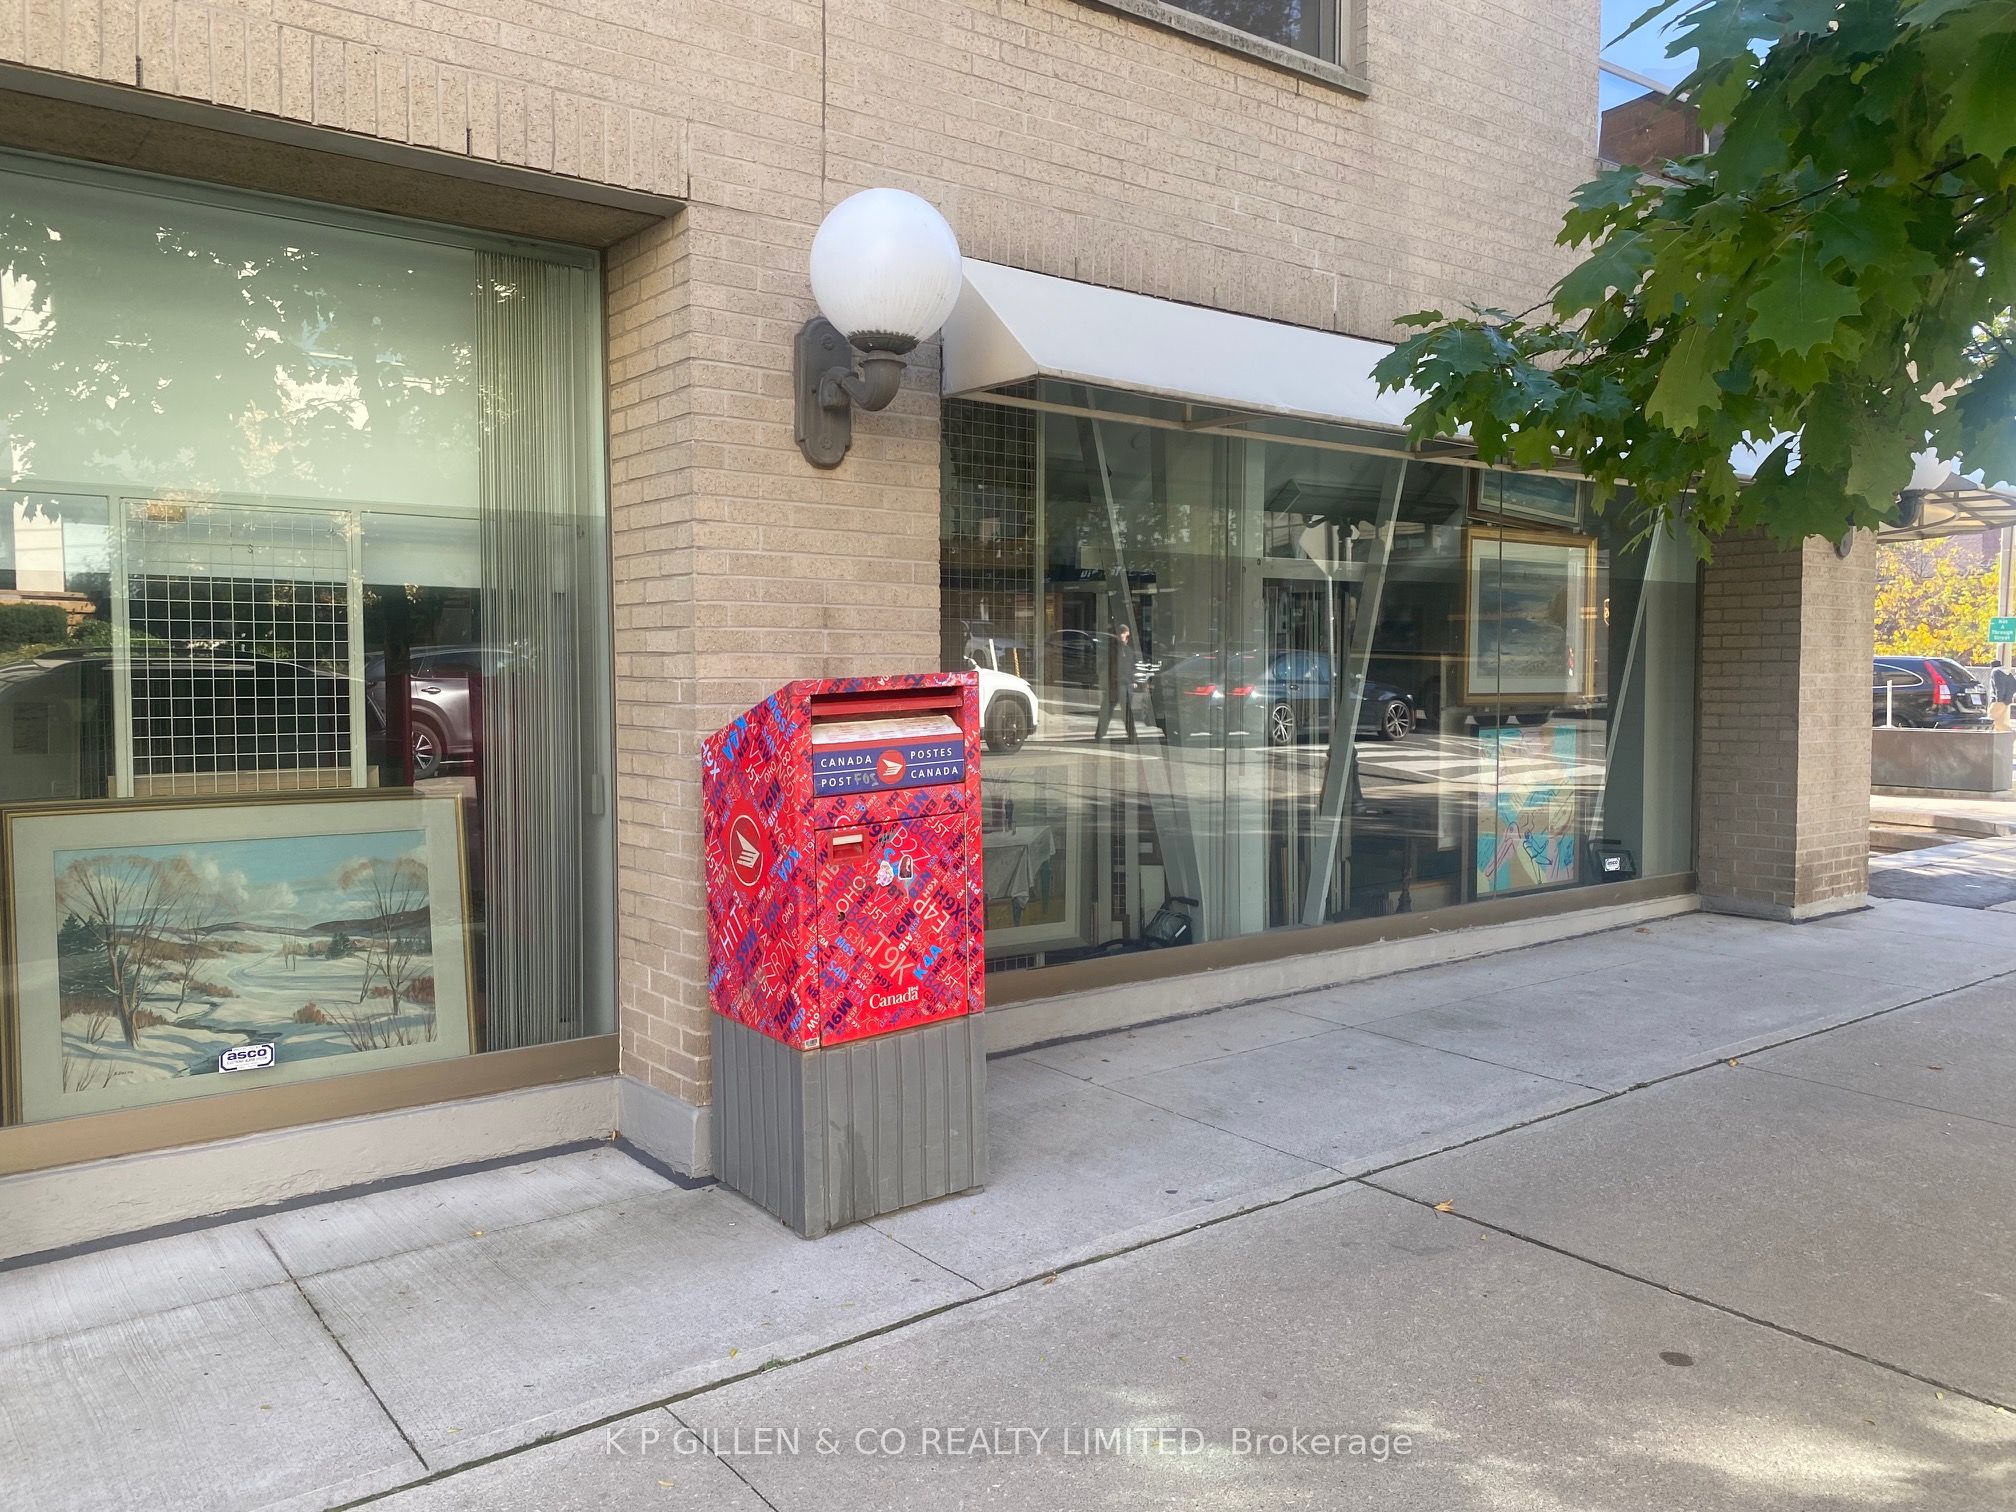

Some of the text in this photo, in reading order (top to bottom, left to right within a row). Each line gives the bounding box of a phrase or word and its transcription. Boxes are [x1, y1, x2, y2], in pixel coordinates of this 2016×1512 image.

[910, 748, 952, 760] POSTES
[820, 755, 872, 768] CANADA
[910, 766, 959, 779] CANADA
[821, 776, 852, 788] POST
[869, 931, 915, 986] T9K
[870, 987, 918, 1009] Canada
[227, 1049, 267, 1060] asco
